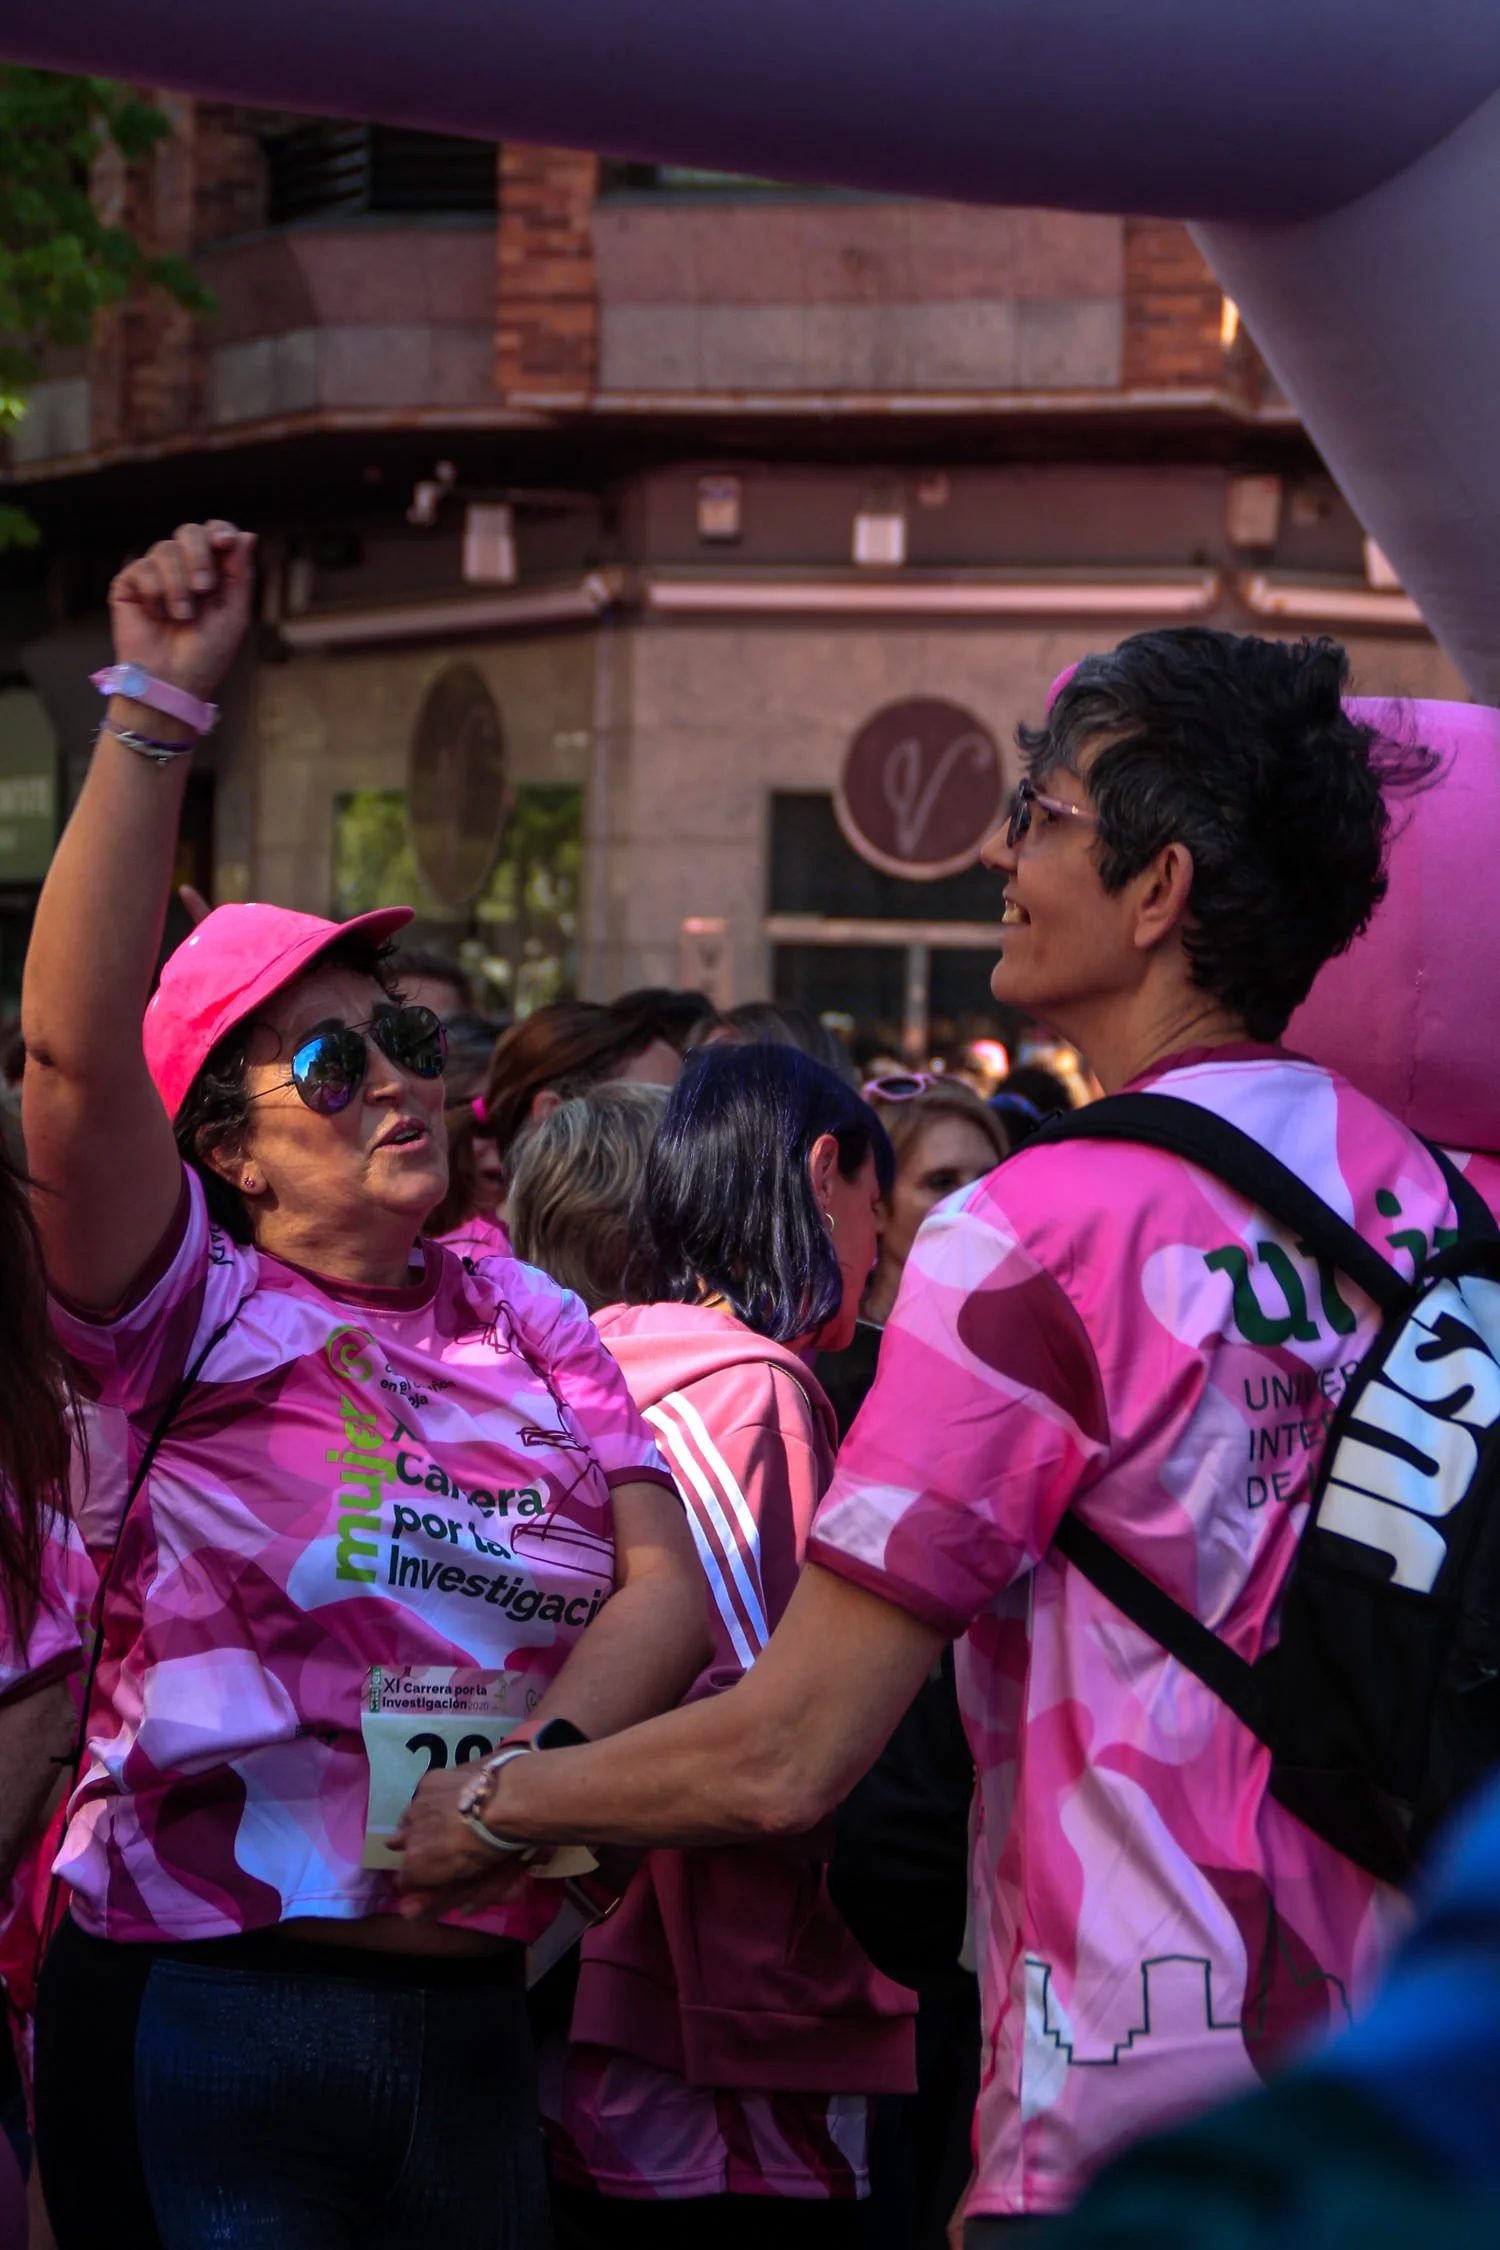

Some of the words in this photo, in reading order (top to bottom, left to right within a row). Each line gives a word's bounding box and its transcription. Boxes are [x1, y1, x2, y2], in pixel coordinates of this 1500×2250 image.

[326, 1394, 397, 1584] mujer
[1247, 1472, 1291, 1509] DE
[392, 1503, 463, 1544] por
[468, 1520, 512, 1560] la
[383, 1677, 400, 1693] XI
[404, 1682, 452, 1695] Carrera
[455, 1684, 475, 1699] por
[476, 1684, 487, 1696] la
